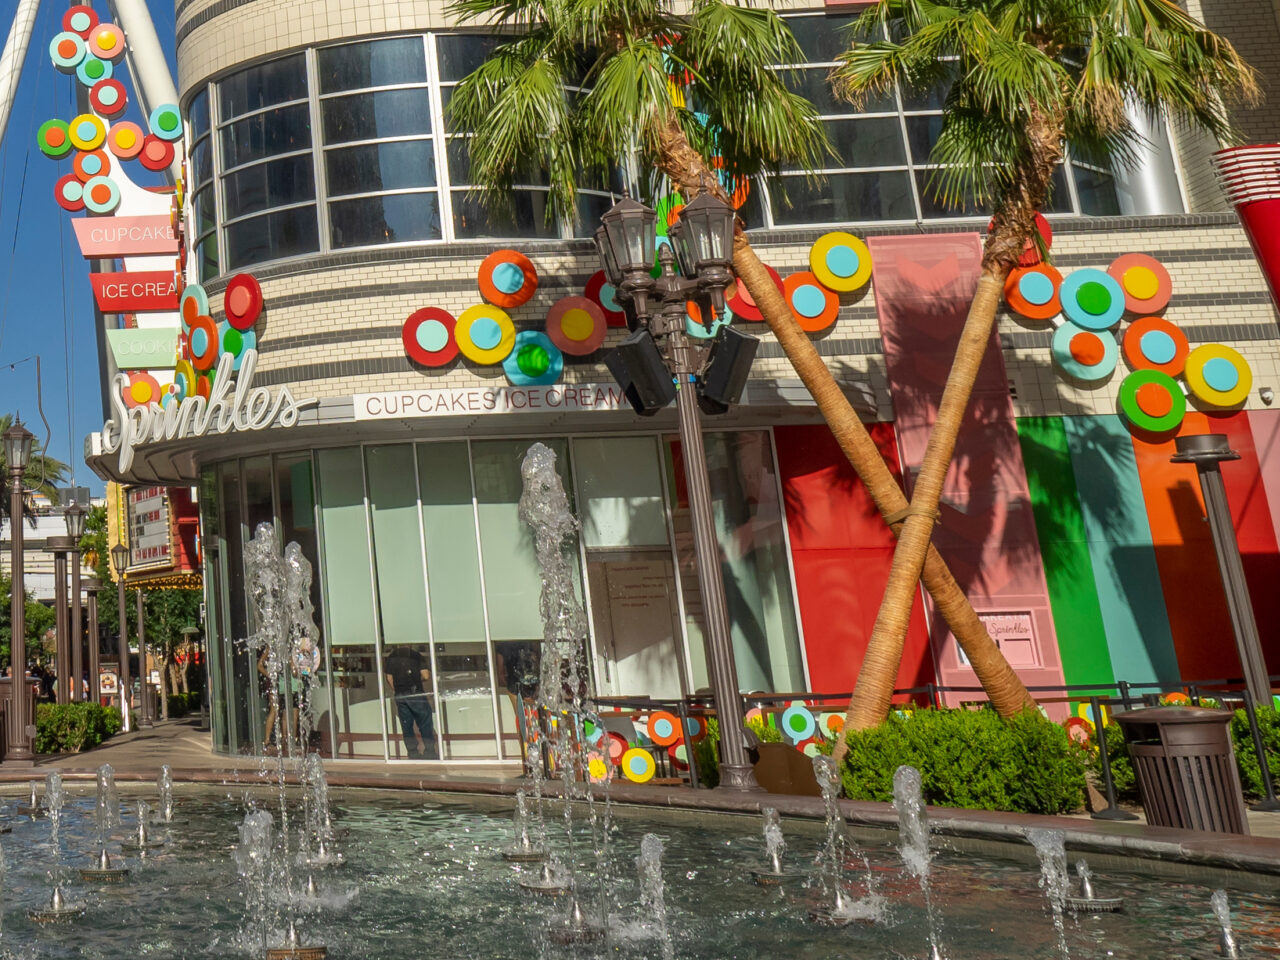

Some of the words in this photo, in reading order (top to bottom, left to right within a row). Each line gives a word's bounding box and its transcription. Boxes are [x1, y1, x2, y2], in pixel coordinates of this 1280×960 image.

[91, 225, 175, 243] CUPCAKE
[102, 283, 128, 299] ICE
[131, 282, 179, 298] CREA
[118, 339, 177, 356] COOKI
[366, 391, 496, 416] CUPCAKES
[505, 389, 541, 409] ICE
[546, 387, 628, 408] CREAM
[103, 348, 319, 474] Sprinkles
[989, 622, 1030, 637] Sprinkles
